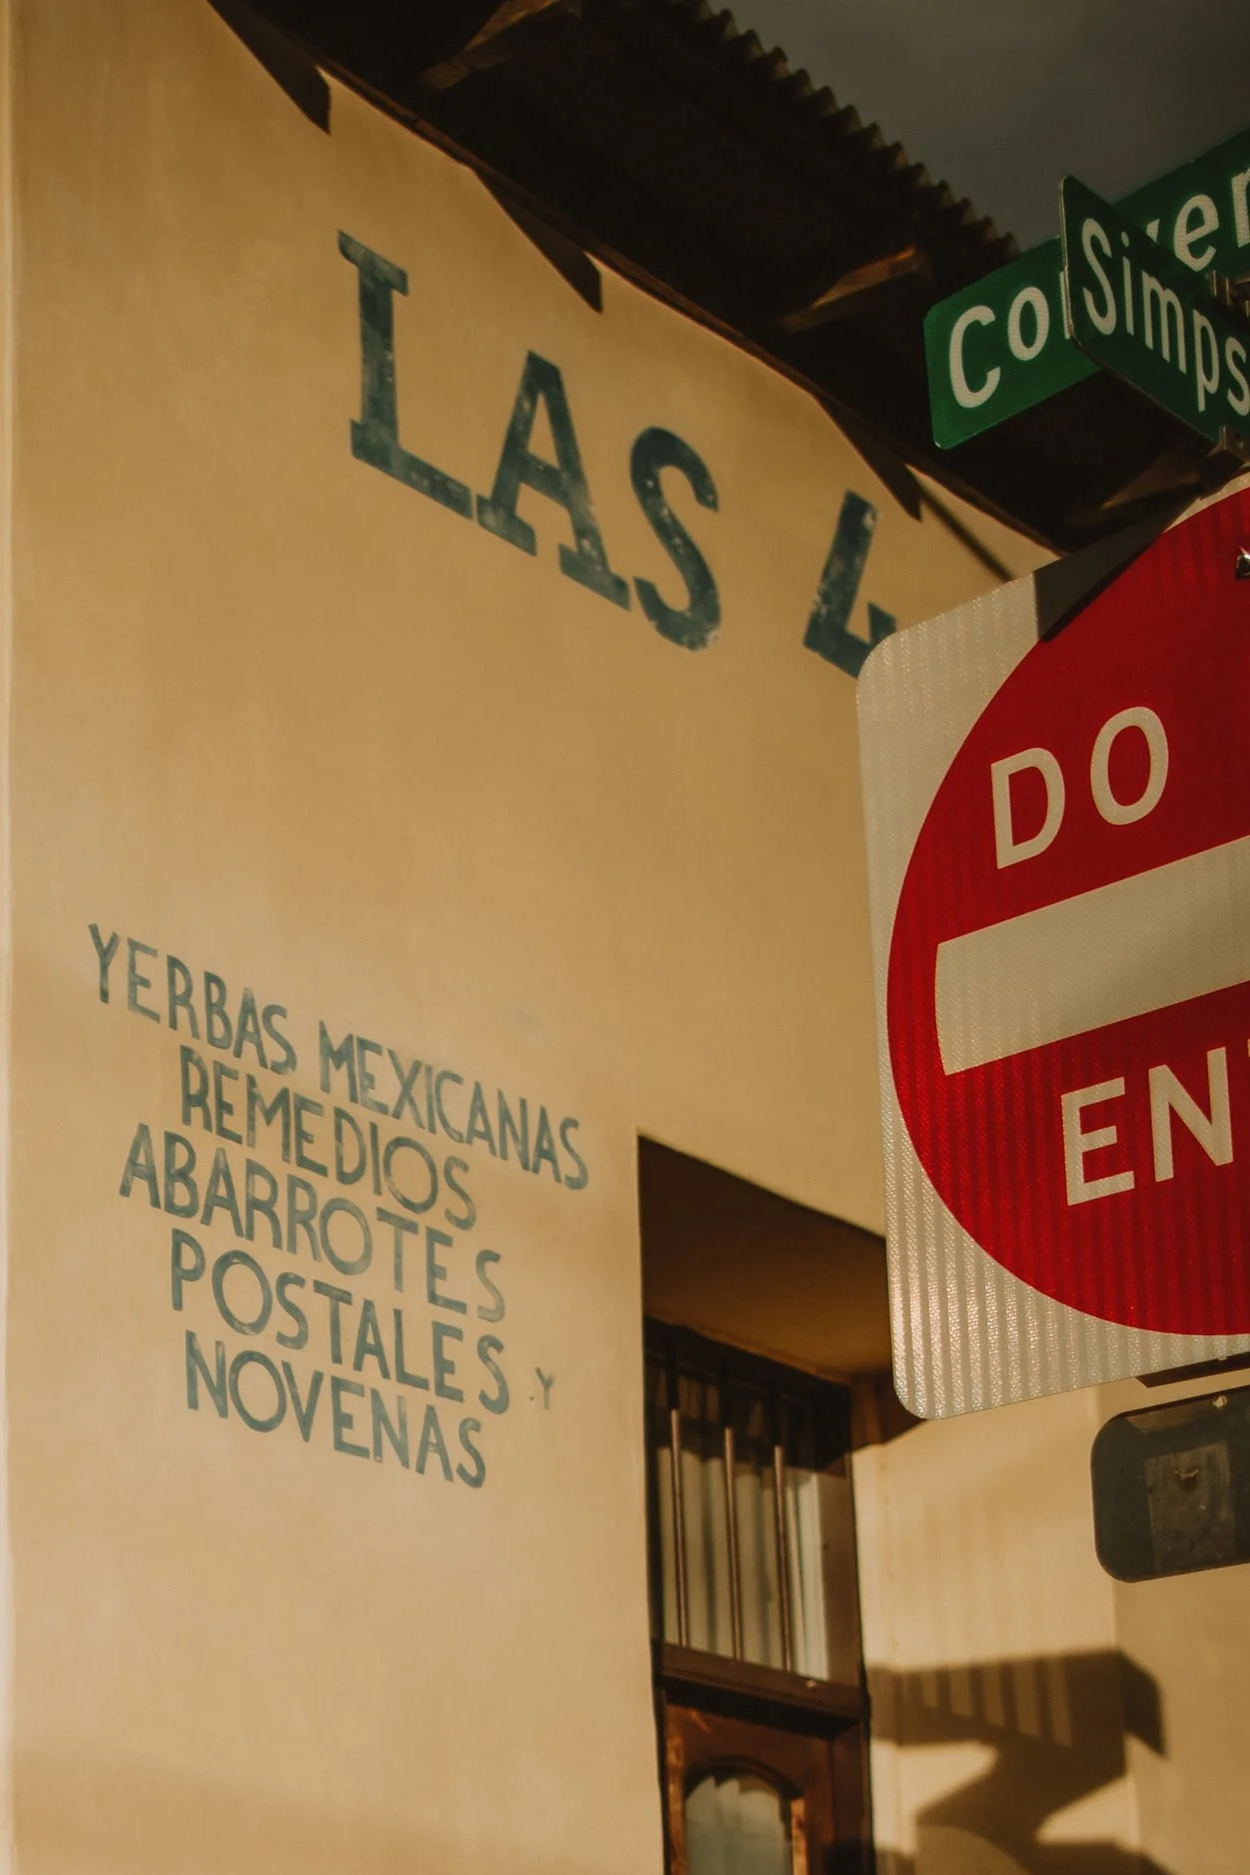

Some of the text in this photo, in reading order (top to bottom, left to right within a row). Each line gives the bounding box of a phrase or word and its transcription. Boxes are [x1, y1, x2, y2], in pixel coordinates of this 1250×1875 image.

[338, 229, 722, 652] LAS
[990, 705, 1171, 870] DO
[88, 922, 589, 1191] YERBAS MEXICANAS
[179, 1044, 477, 1231] REMEDIOS
[1061, 1036, 1250, 1206] EN
[118, 1121, 507, 1324] ABARROTES
[170, 1228, 556, 1416] POSTALES Y
[185, 1329, 487, 1489] NOVENAS
